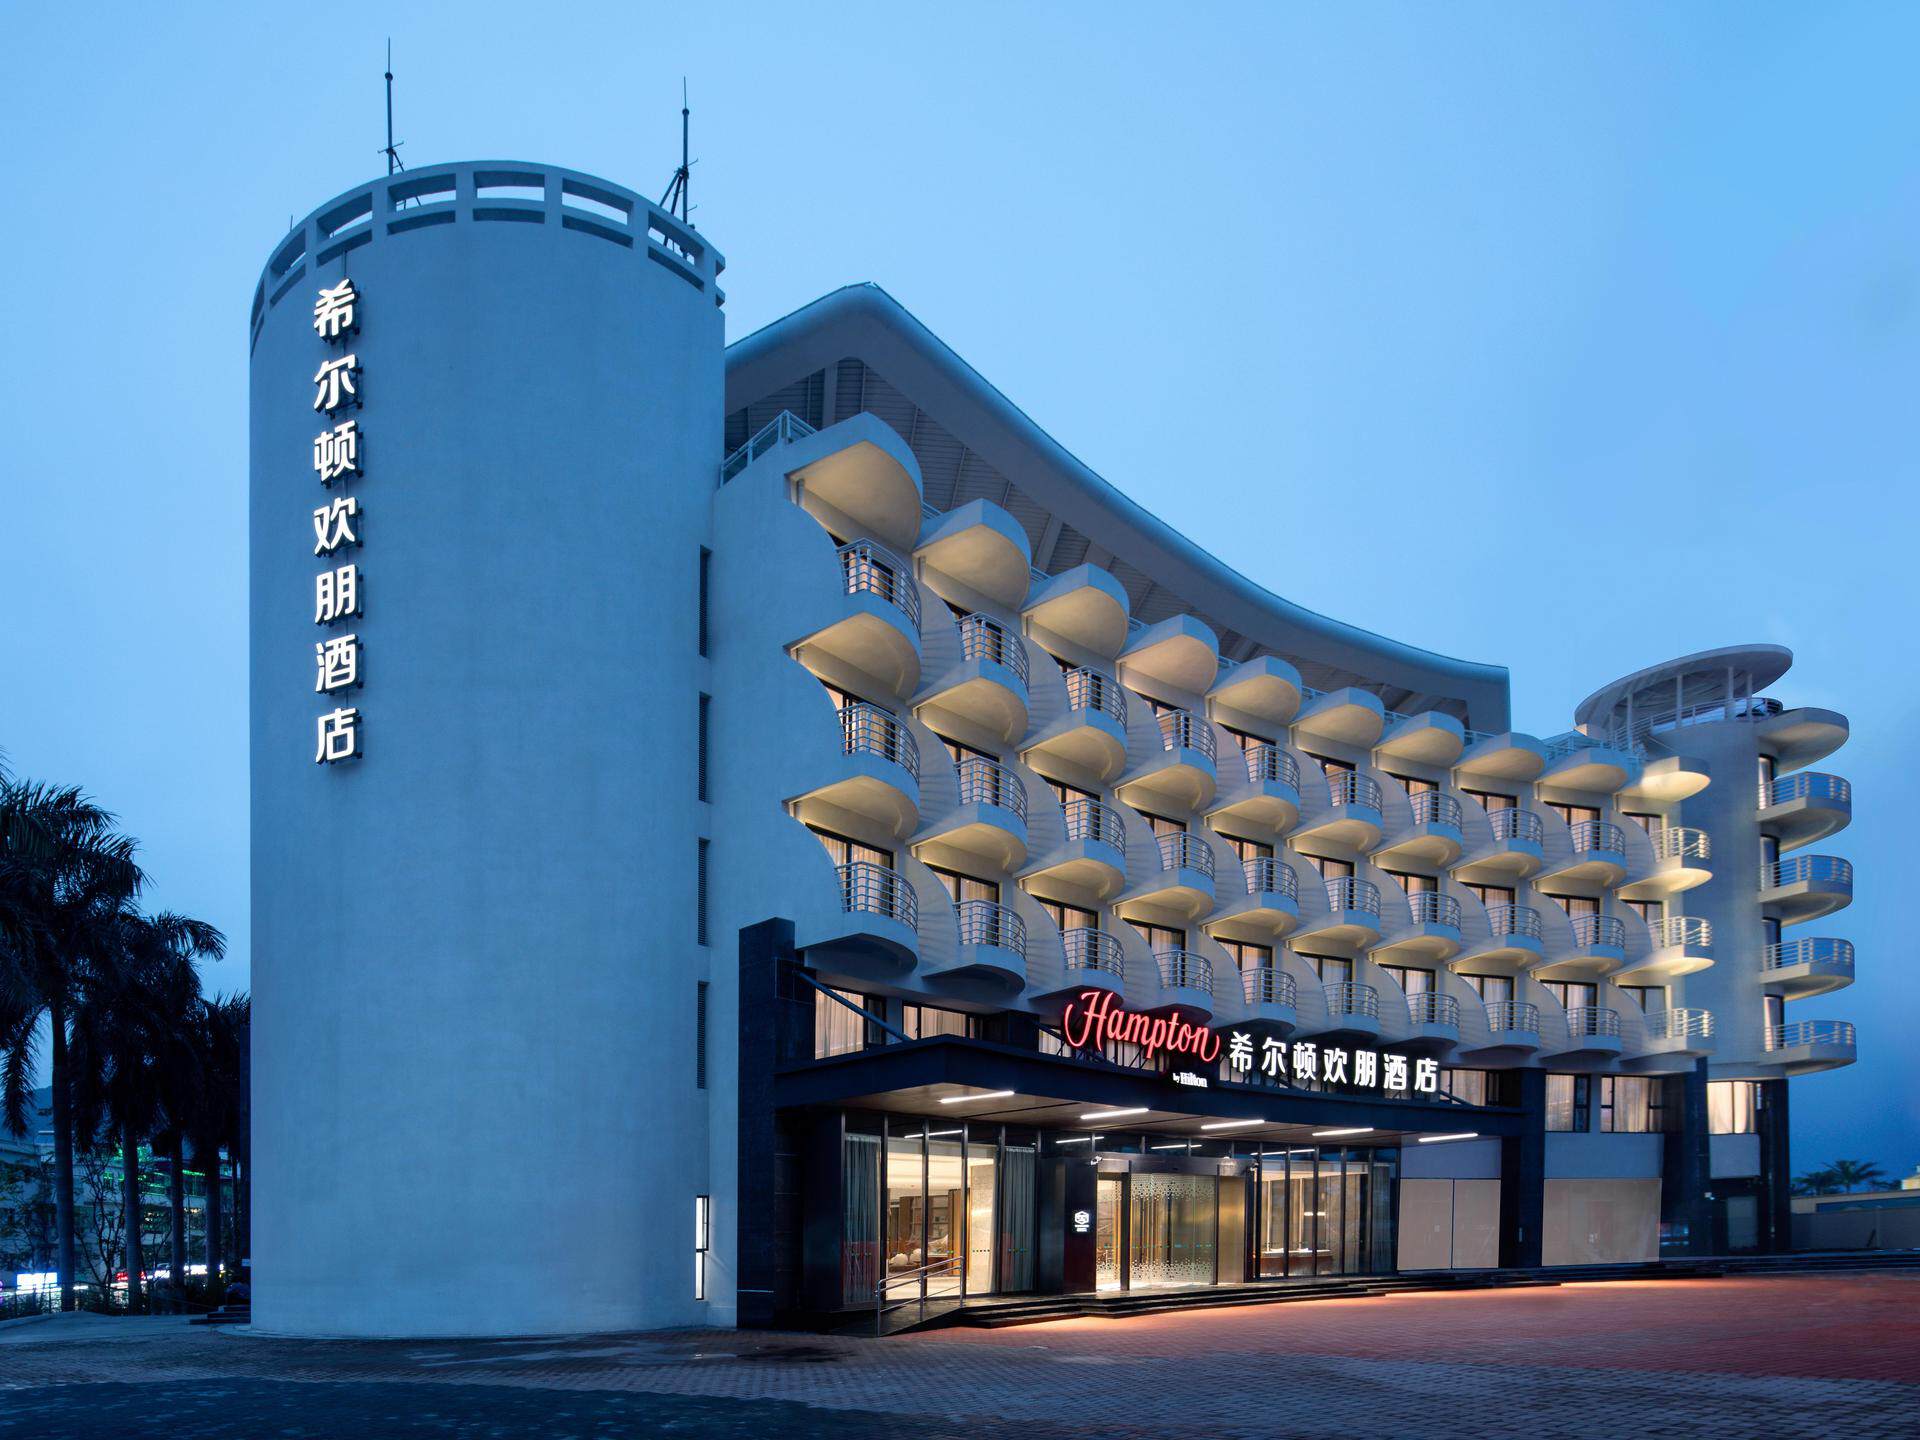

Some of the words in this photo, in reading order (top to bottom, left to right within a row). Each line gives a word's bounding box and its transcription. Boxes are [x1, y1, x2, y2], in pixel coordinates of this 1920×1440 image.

[313, 278, 358, 765] 希尔顿欢朋酒店
[1064, 991, 1220, 1062] Hampton
[1172, 1072, 1180, 1084] by
[1180, 1071, 1208, 1088] Hilton
[1229, 1031, 1439, 1093] 希尔顿欢朋酒店
